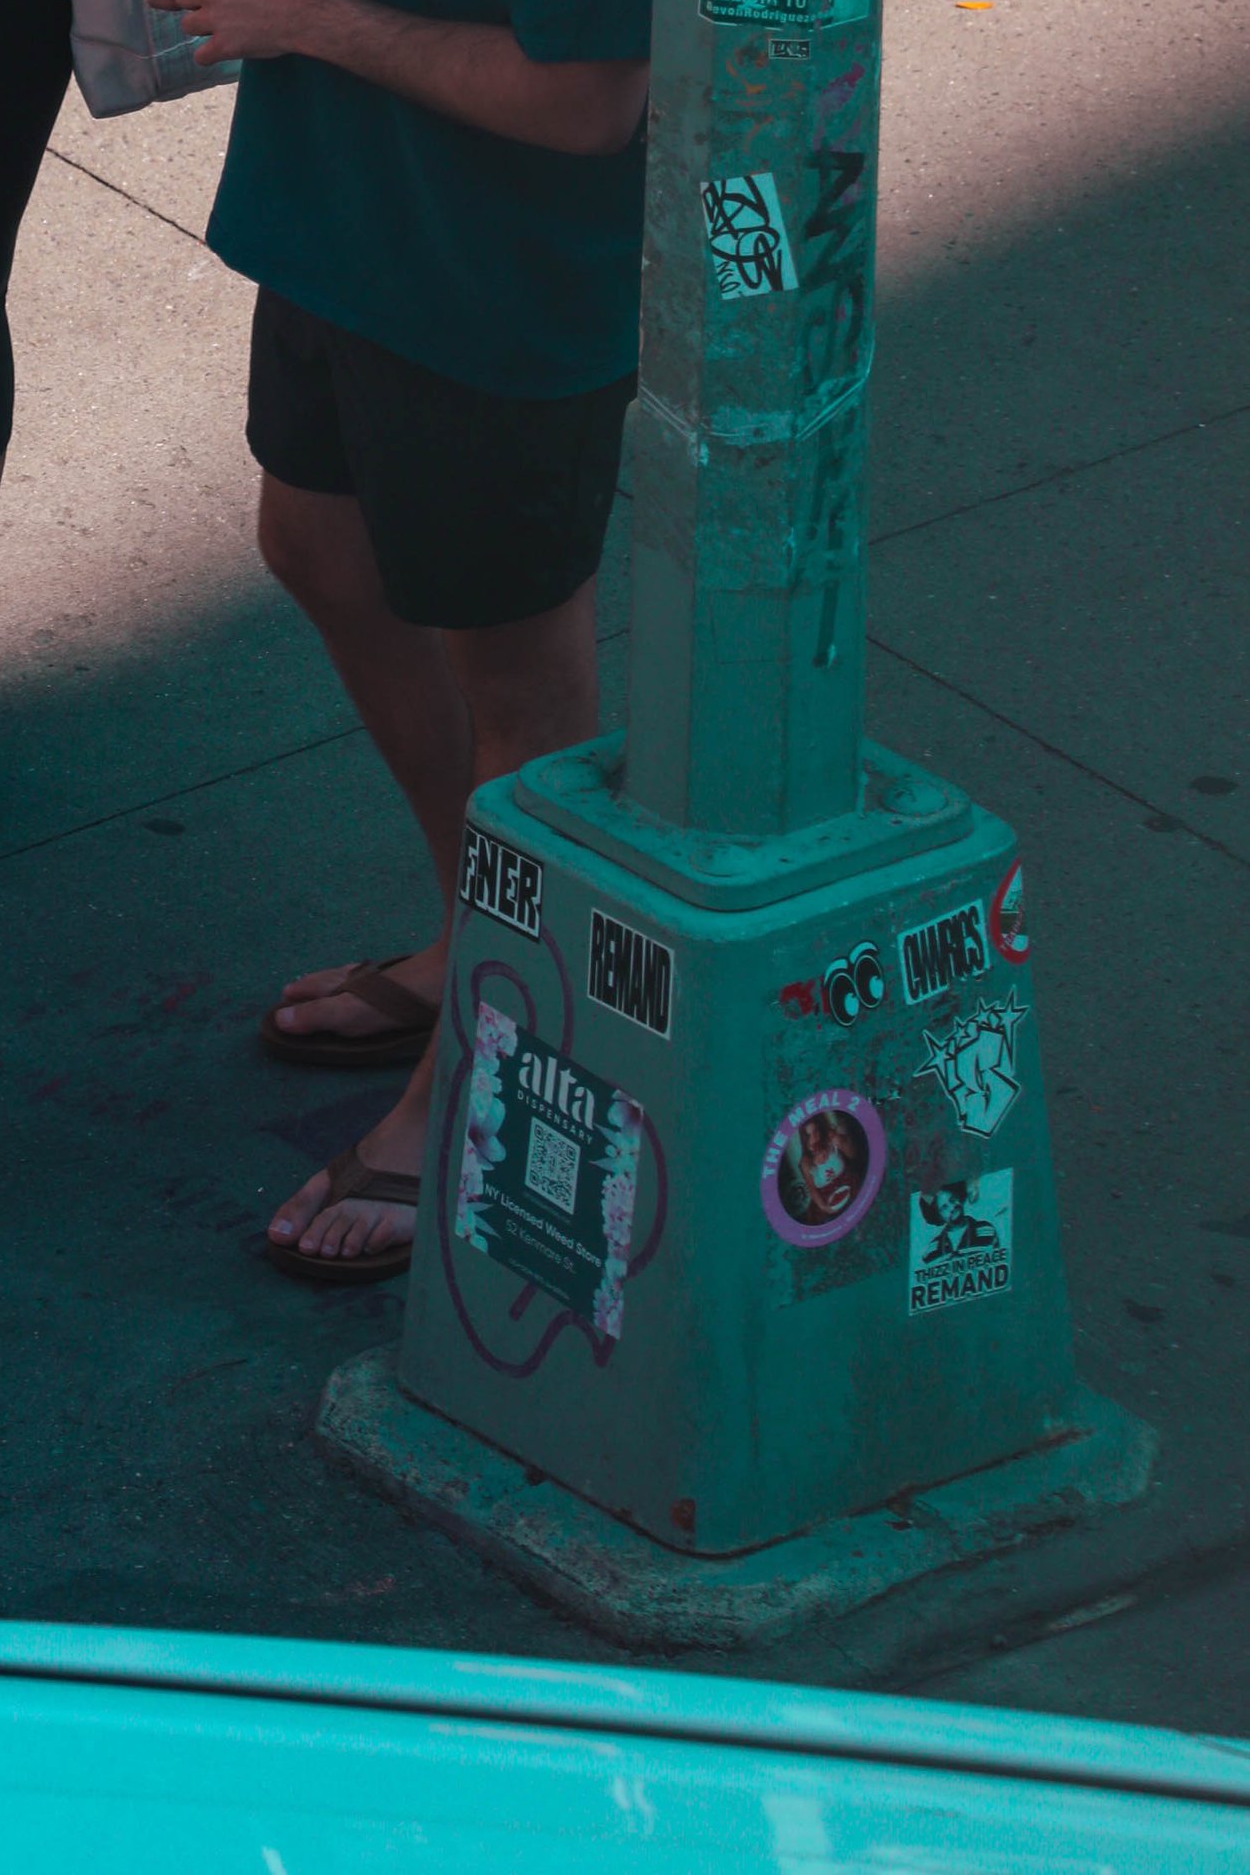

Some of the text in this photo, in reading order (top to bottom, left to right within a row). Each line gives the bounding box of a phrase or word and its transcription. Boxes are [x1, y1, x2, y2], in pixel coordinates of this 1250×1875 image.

[588, 909, 672, 1038] REMAND
[517, 1089, 594, 1145] DISPENSARY
[518, 1052, 596, 1130] alta
[763, 1091, 860, 1179] THE MEAL 2
[500, 1192, 544, 1230] Licensed
[546, 1224, 575, 1250] Weed
[575, 1240, 602, 1268] Store
[952, 1258, 965, 1274] IN
[910, 1264, 1009, 1310] REMAND
